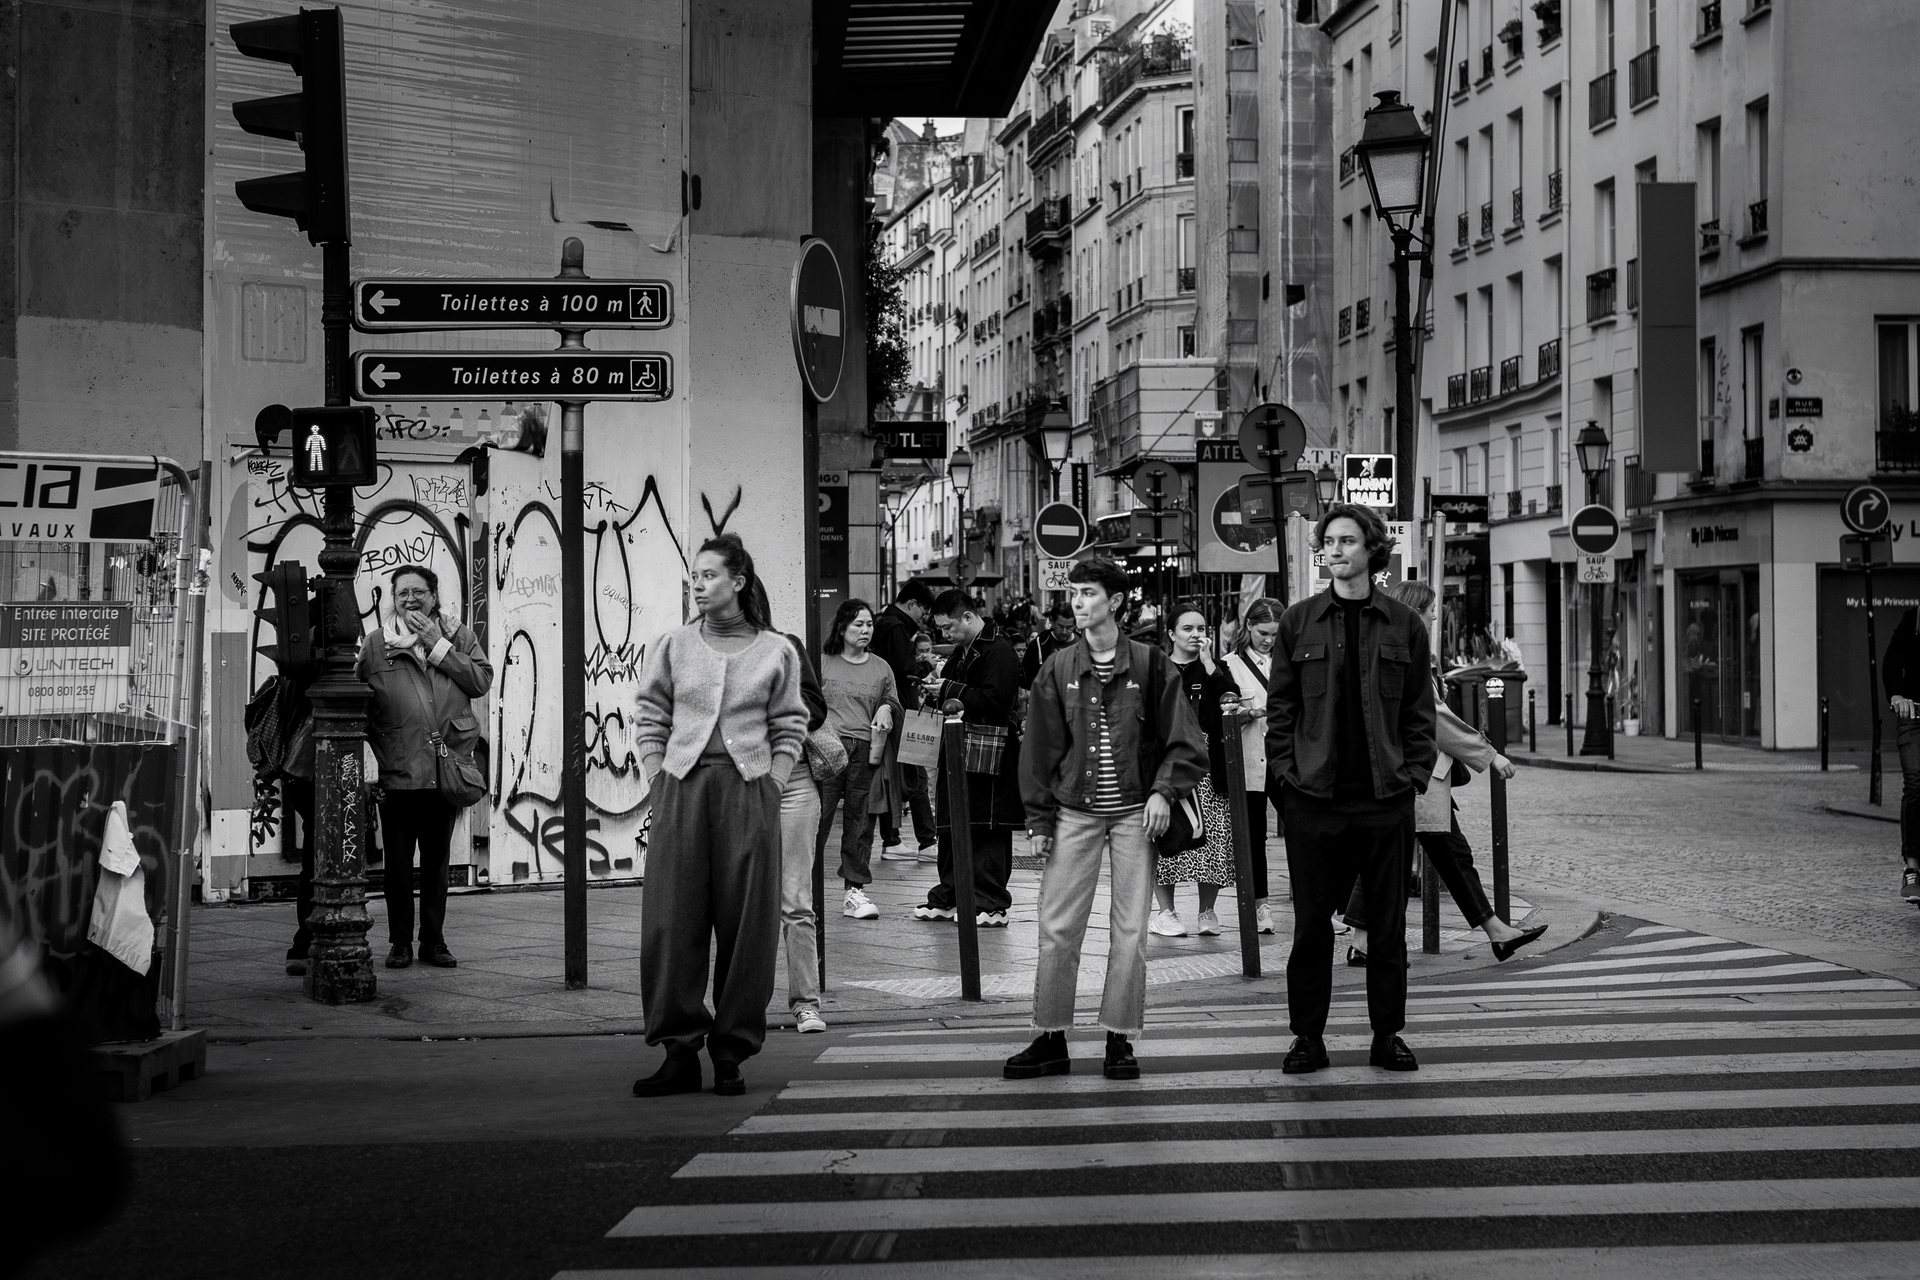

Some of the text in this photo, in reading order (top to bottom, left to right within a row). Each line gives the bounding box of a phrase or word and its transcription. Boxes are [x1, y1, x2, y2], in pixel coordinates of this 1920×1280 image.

[440, 294, 623, 313] Toilettes à 100 m
[451, 367, 624, 385] Toilettes à 80 m
[875, 432, 944, 449] OUTLET
[1203, 445, 1247, 460] ATTE
[1347, 477, 1394, 492] SUNNY
[1349, 491, 1390, 505] NAILS
[0, 523, 75, 539] VAUX
[1691, 527, 1699, 548] My
[1715, 525, 1738, 542] Princess
[1048, 561, 1071, 569] SAUF
[1585, 557, 1606, 565] SAUF
[1846, 597, 1859, 608] My
[1884, 597, 1919, 607] Princess
[14, 606, 119, 620] Entrée interdite
[21, 624, 111, 641] SITE PROTÉGÉ
[36, 657, 114, 672] UNITECH
[28, 685, 95, 698] 0800 801 255
[917, 733, 935, 743] LABO
